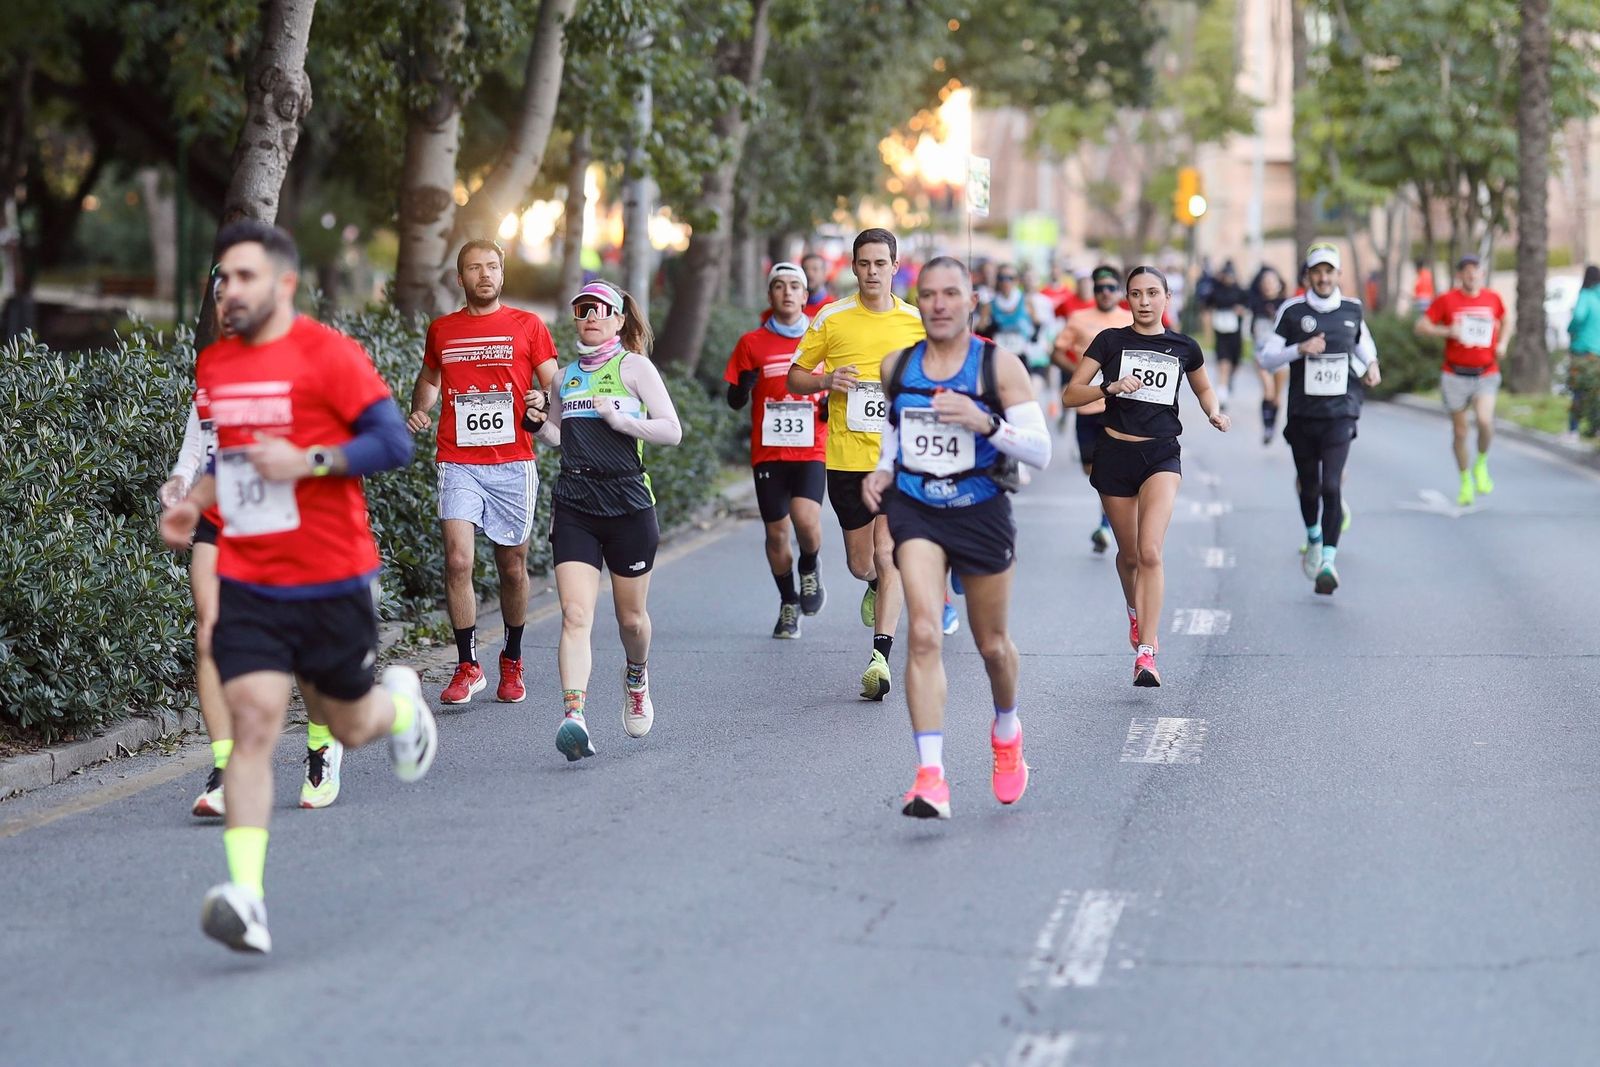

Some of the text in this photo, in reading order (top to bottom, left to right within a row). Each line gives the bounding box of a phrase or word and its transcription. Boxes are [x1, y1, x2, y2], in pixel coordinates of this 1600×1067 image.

[458, 353, 513, 362] PALMA PALMILLA
[1132, 367, 1168, 389] 580
[1314, 370, 1341, 383] 496
[466, 411, 504, 431] 666
[772, 418, 804, 433] 333
[915, 434, 960, 457] 954
